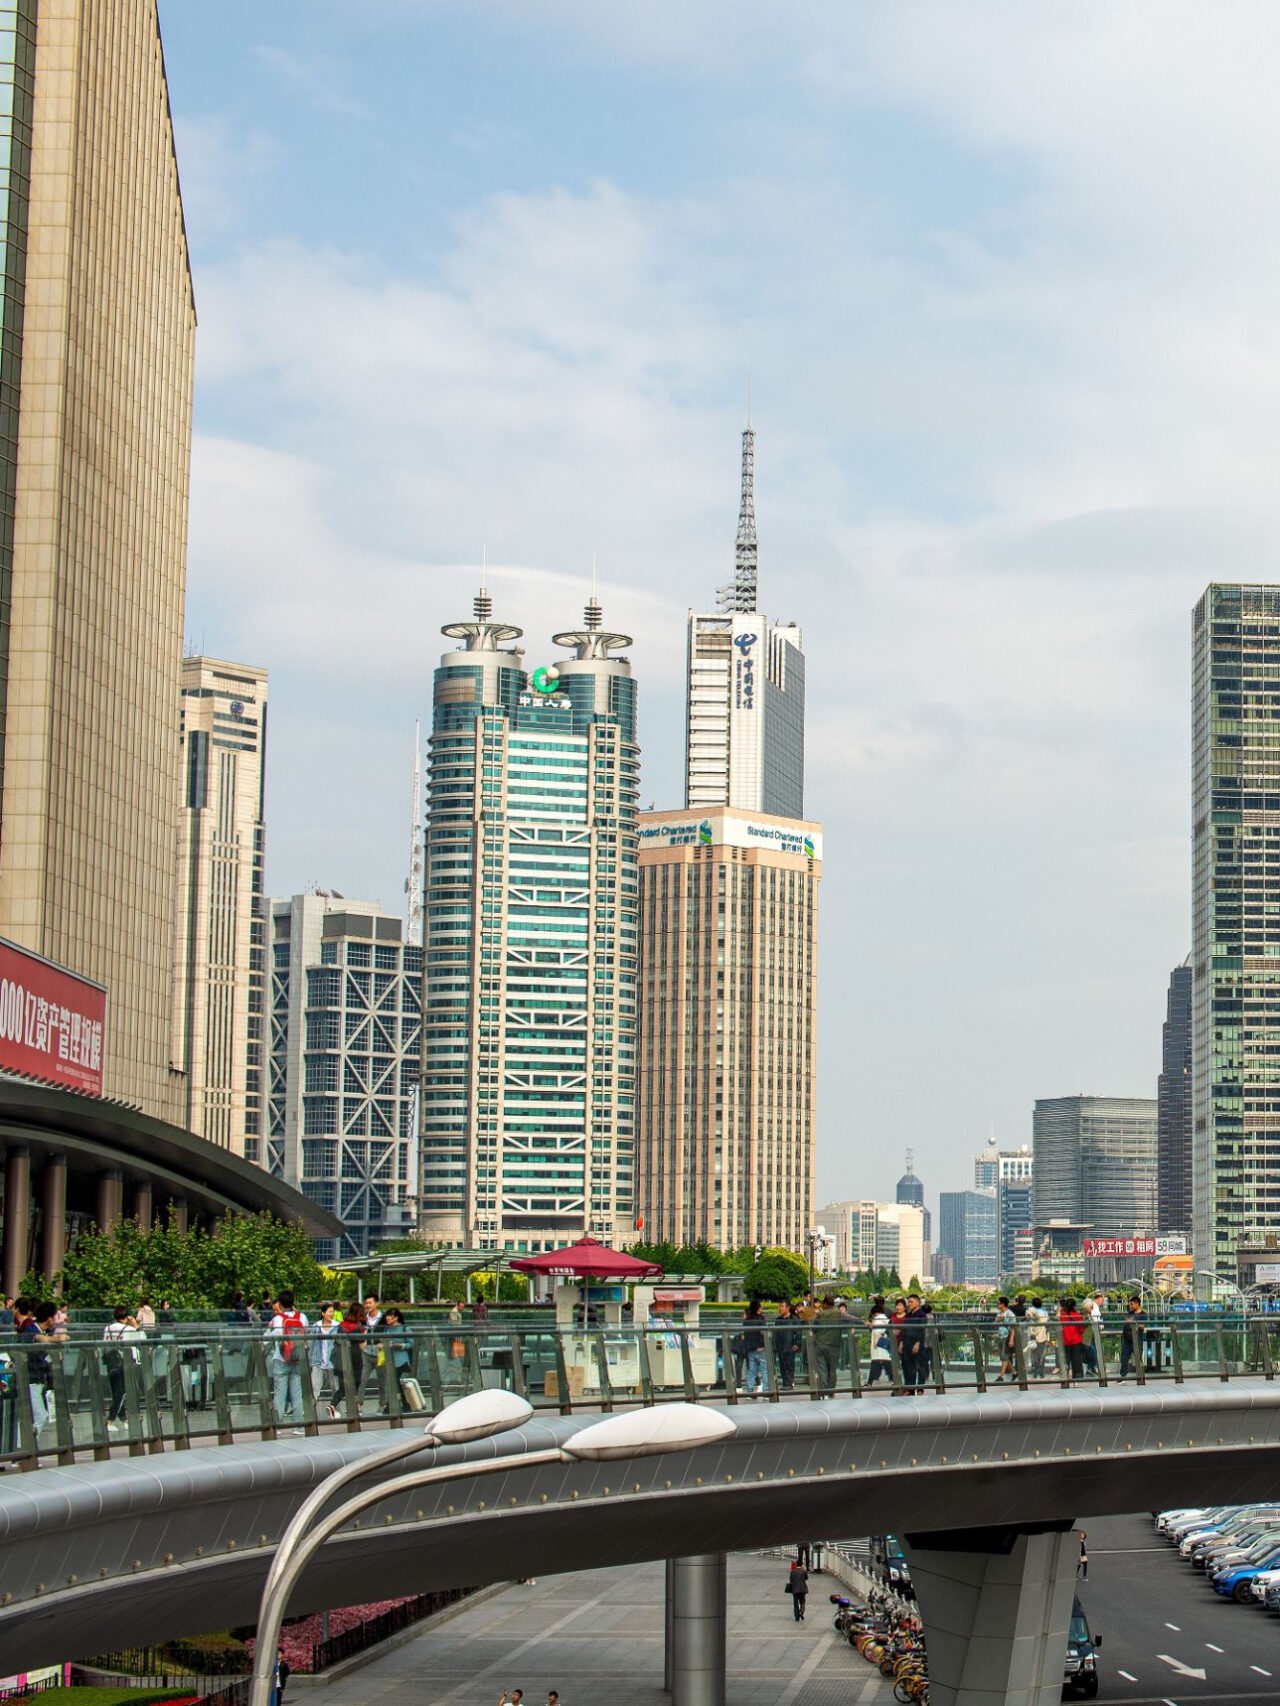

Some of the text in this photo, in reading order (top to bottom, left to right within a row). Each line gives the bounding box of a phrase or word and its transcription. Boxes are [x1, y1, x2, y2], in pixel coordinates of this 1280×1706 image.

[747, 825, 803, 844] Standard Chartered
[1097, 1240, 1124, 1254] 找工作
[1136, 1240, 1154, 1253] 租房
